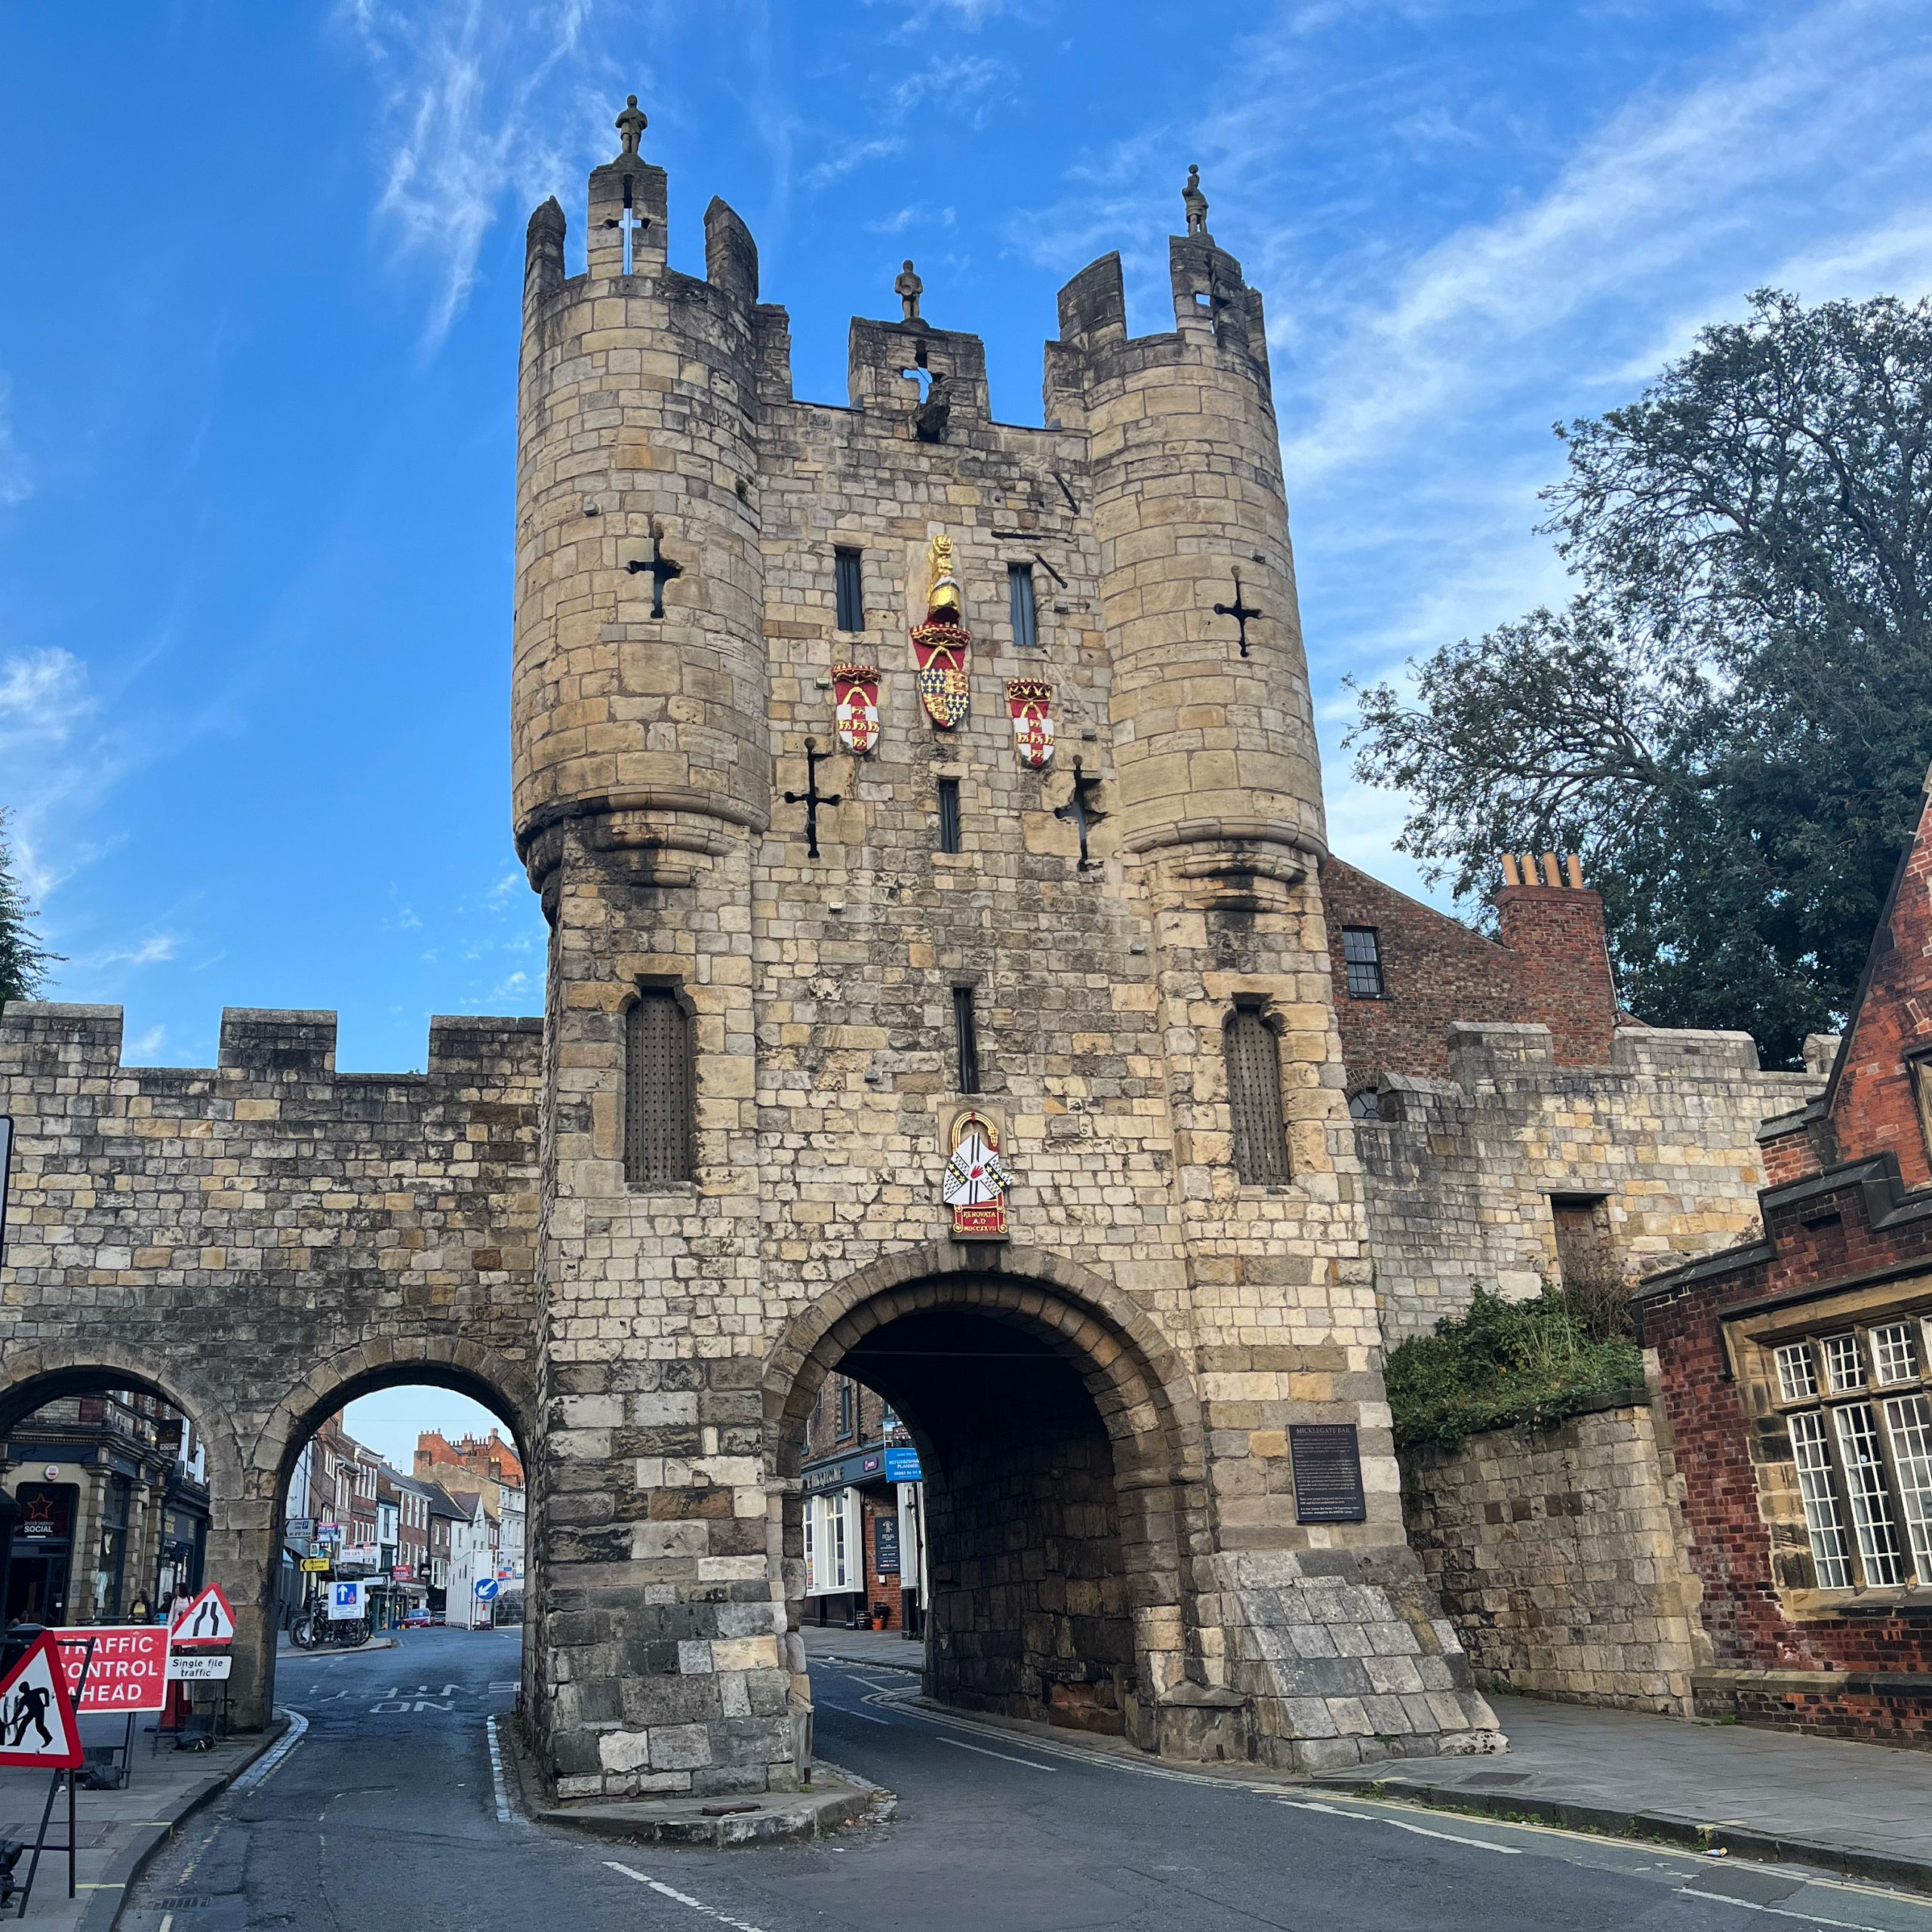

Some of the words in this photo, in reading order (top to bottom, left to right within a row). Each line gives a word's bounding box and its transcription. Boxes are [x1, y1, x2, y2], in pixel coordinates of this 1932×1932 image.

[63, 1636, 153, 1655] TRAFFIC
[172, 1659, 203, 1668] Single
[208, 1659, 223, 1667] file
[180, 1669, 211, 1677] traffic
